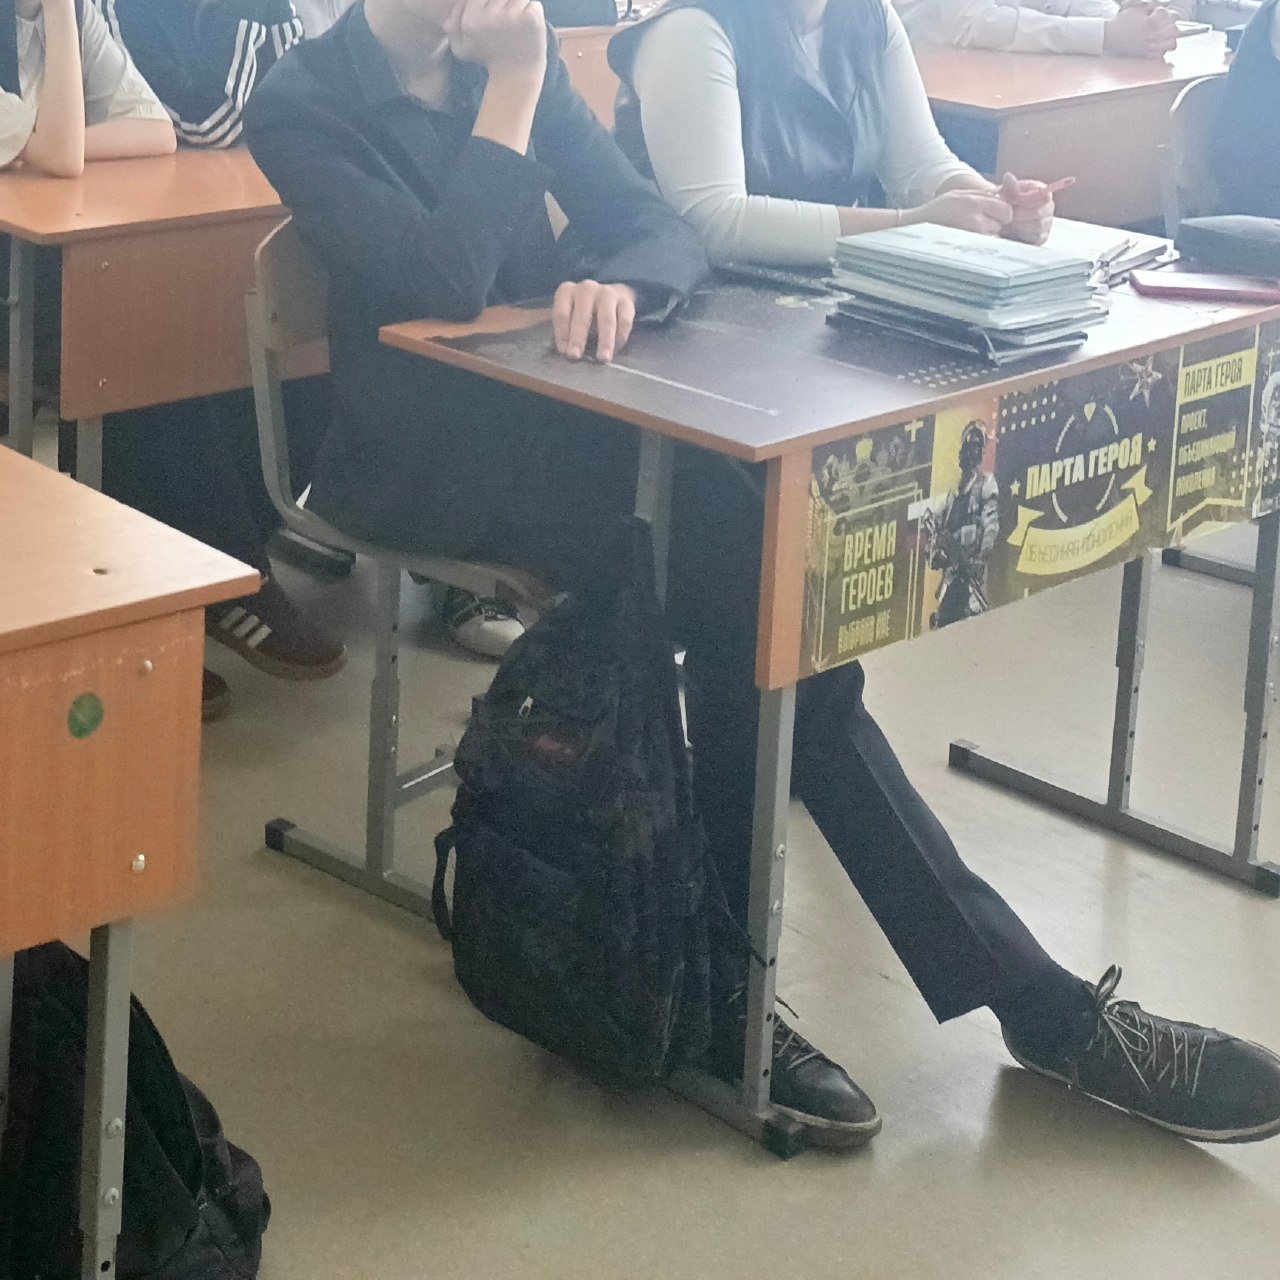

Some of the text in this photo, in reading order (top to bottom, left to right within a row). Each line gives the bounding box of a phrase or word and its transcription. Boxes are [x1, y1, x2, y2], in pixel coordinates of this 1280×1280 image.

[1184, 357, 1243, 397] ПАРТА ГЕРОЯ
[1025, 432, 1143, 500] ПАРТА ГЕРОЯ
[843, 520, 897, 572] ВРЕМЯ
[840, 562, 894, 615] ГЕРОЕВ
